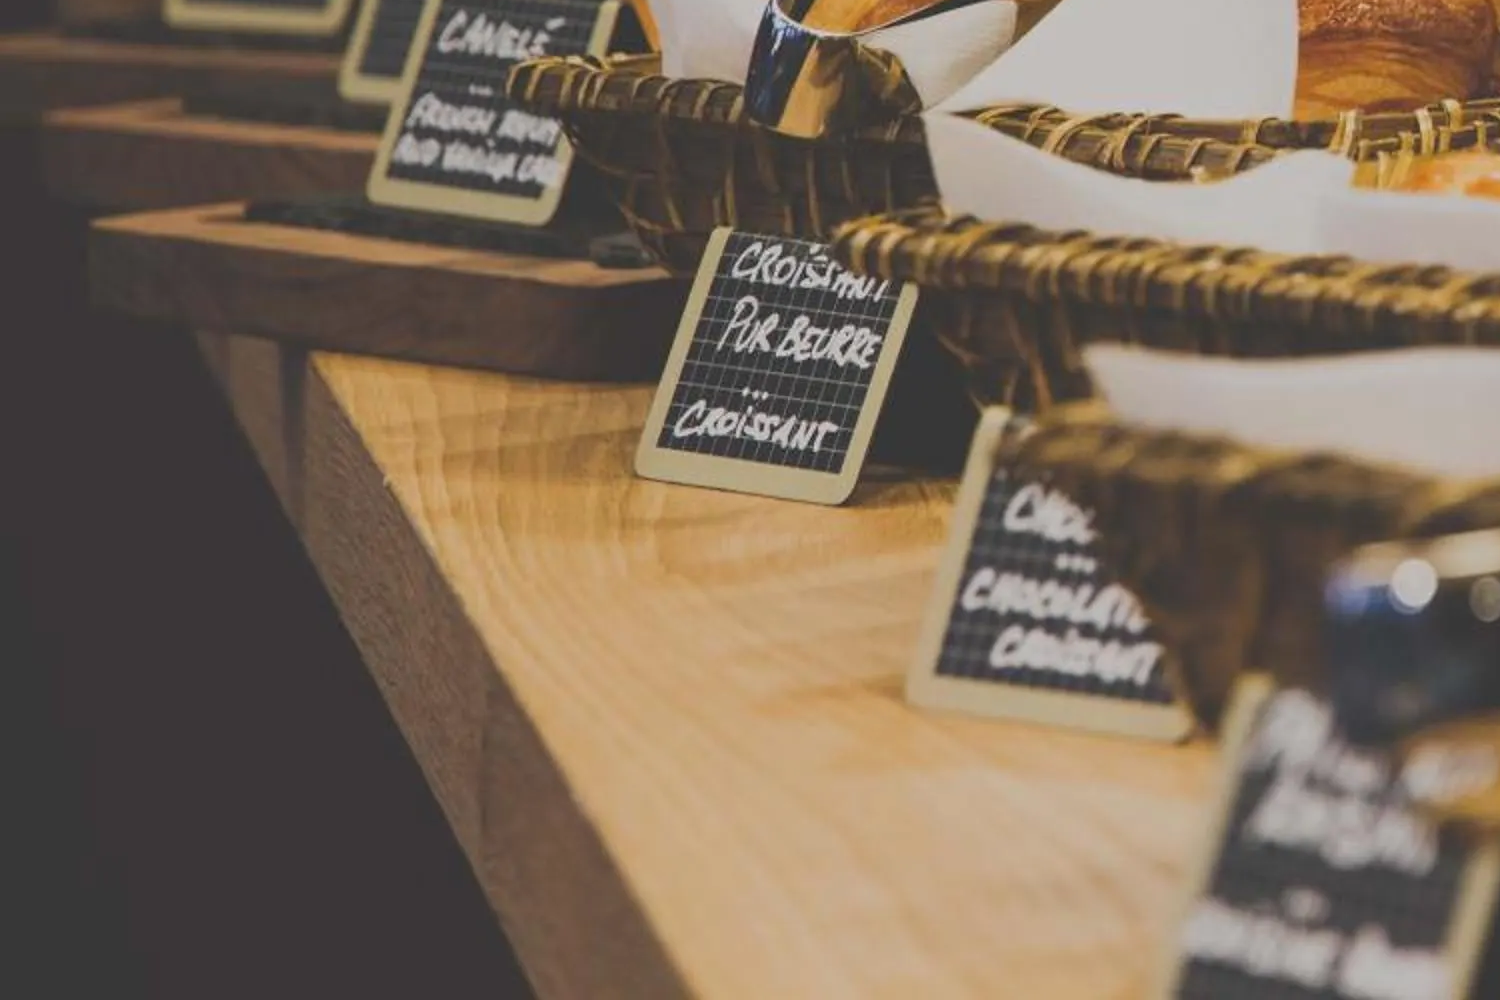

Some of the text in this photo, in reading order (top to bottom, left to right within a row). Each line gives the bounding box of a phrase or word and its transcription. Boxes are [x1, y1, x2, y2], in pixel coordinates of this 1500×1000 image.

[717, 295, 883, 370] PUR BEURRE
[672, 399, 840, 452] CROISSANT
